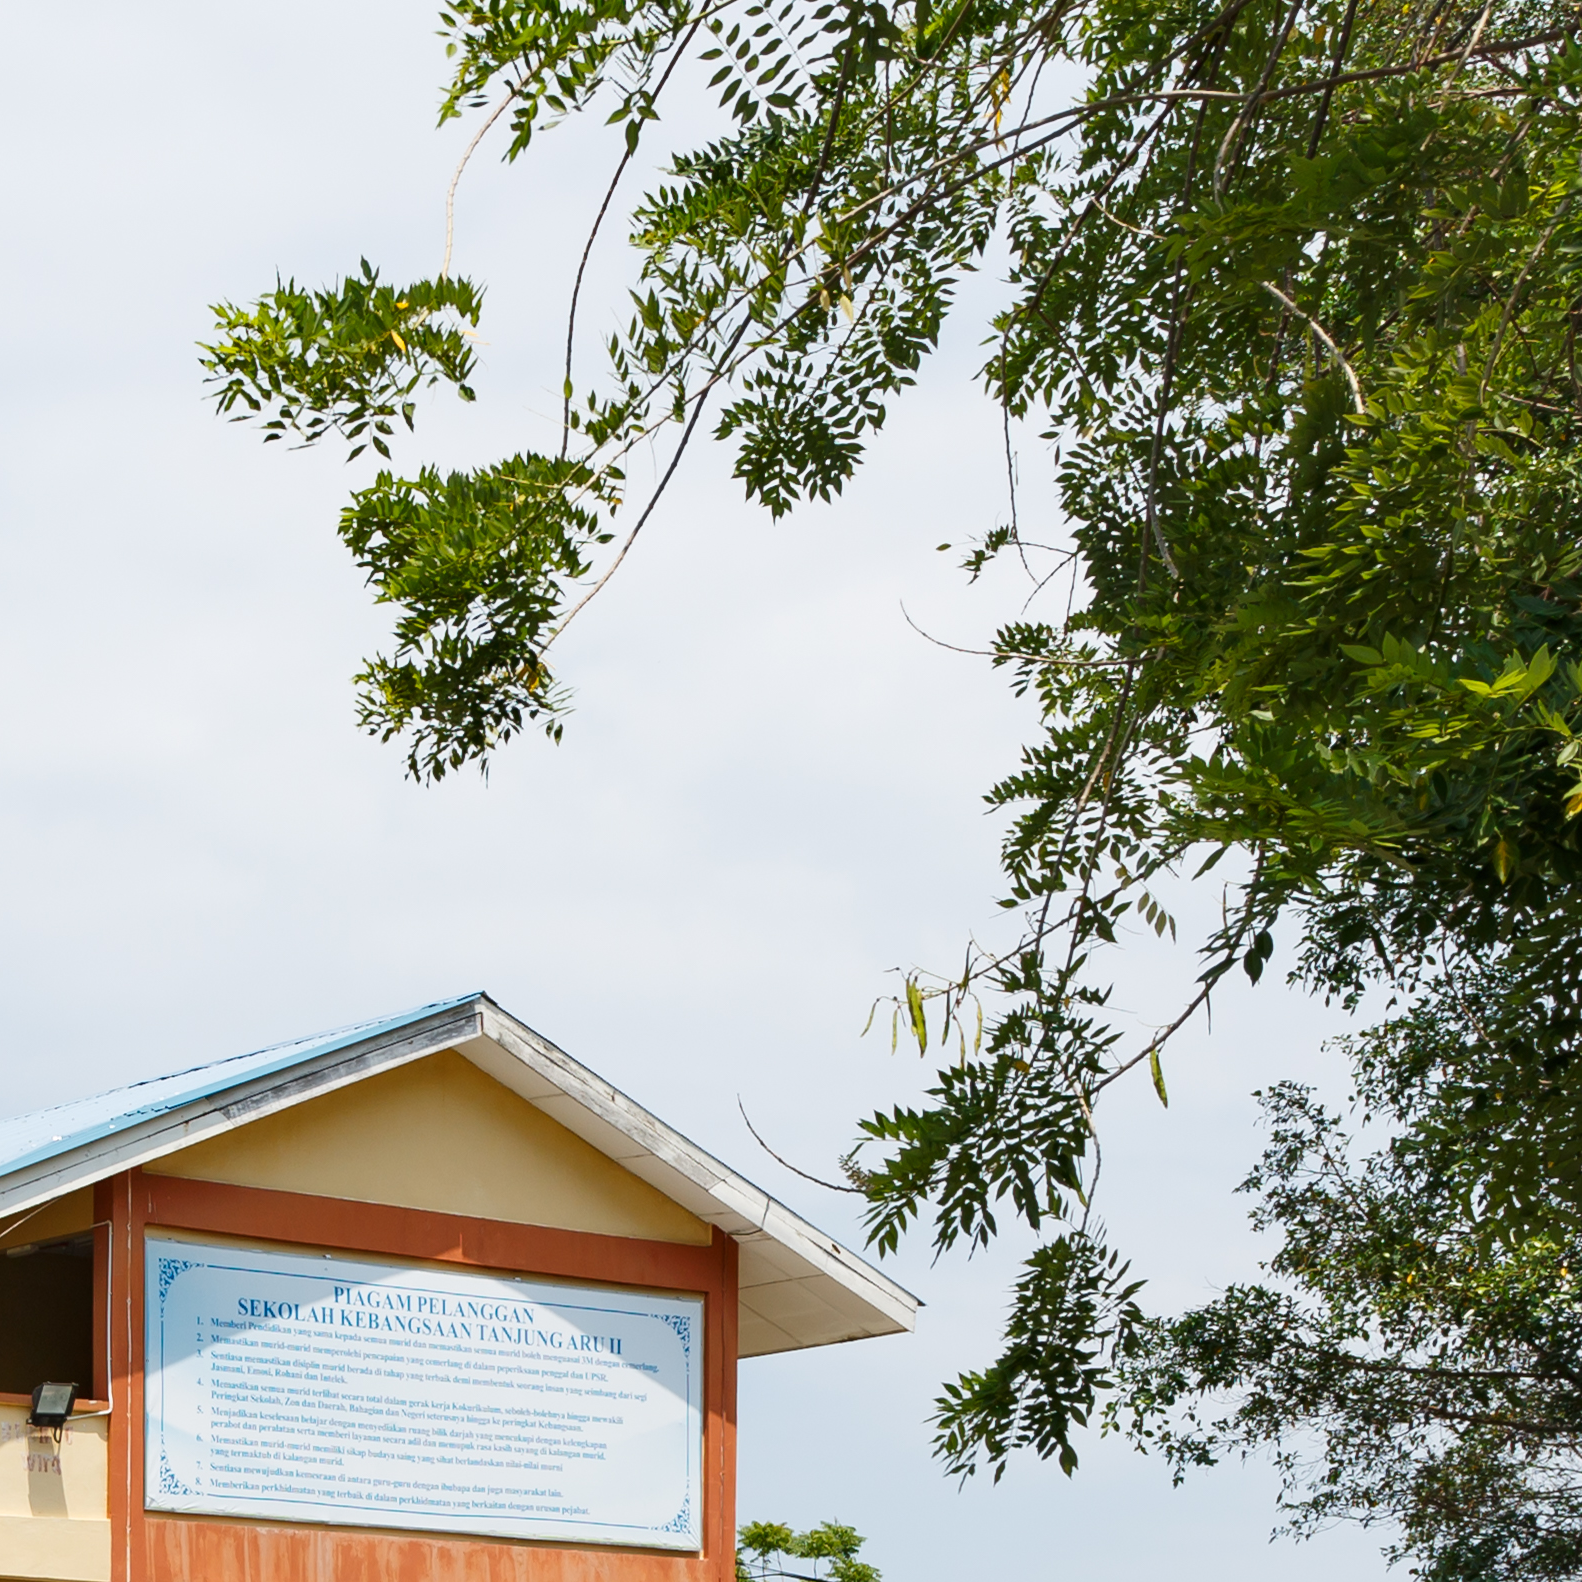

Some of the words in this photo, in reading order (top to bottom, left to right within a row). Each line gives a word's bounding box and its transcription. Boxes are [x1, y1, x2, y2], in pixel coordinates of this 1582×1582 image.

[237, 1297, 334, 1325] SEKOLAH
[340, 1308, 472, 1339] KEBANGSAAN
[476, 1324, 563, 1349] TANJUNG
[566, 1334, 605, 1353] ARU
[609, 1337, 622, 1355] II
[333, 1286, 413, 1313] PIAGAM
[416, 1294, 535, 1324] PELANGGAN
